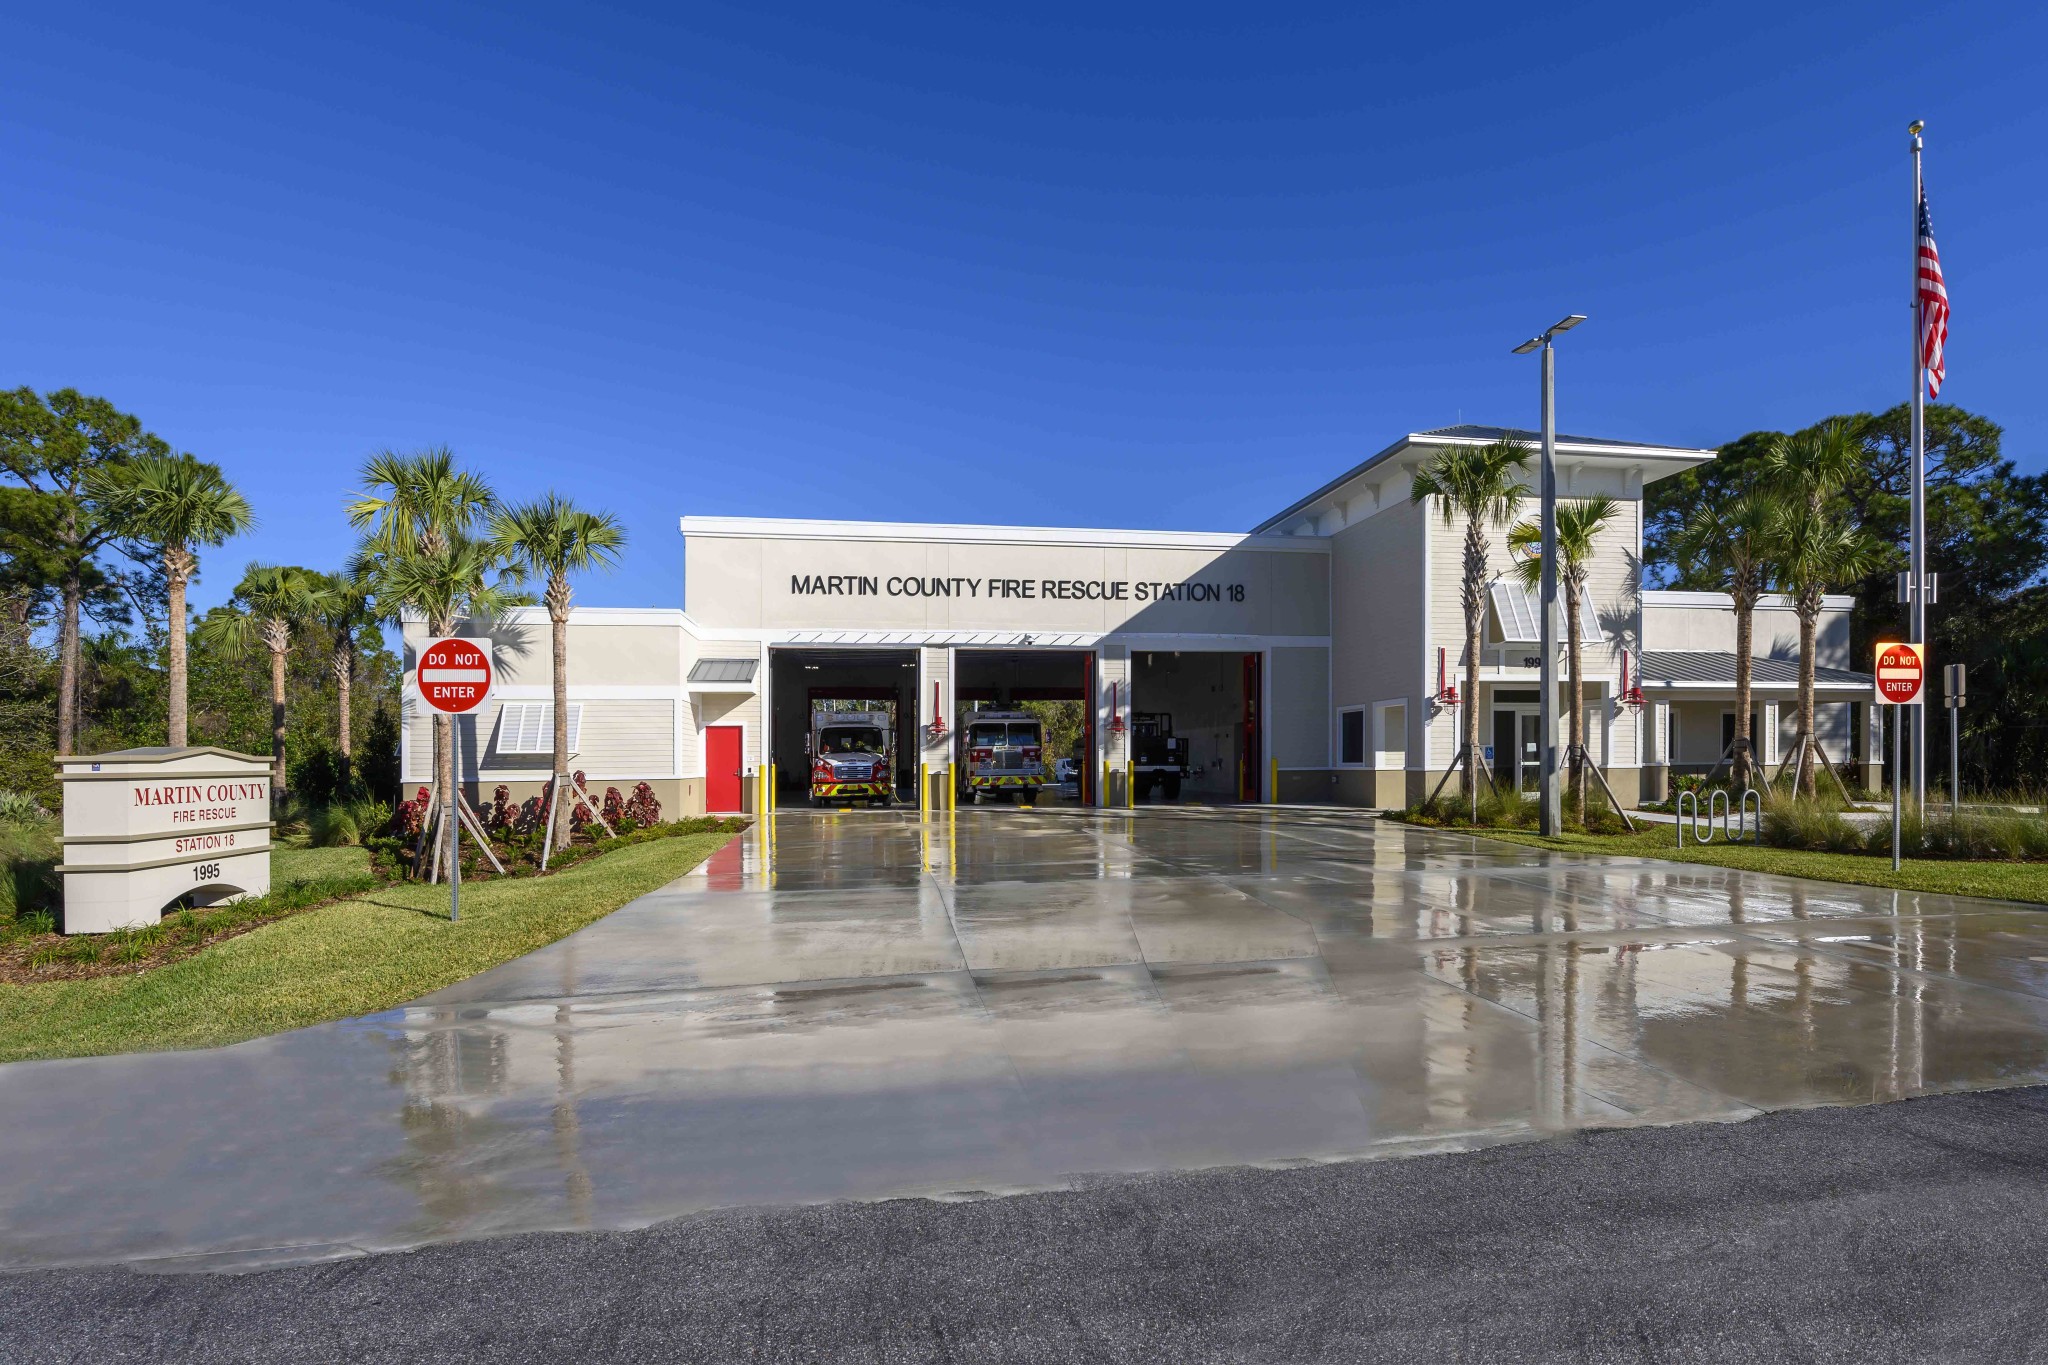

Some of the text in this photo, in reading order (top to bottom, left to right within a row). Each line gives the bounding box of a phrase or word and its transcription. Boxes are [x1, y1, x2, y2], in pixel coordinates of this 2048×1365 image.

[791, 575, 1245, 602] MARTIN COUNTY FIRE RESCUE STATION 18
[429, 654, 480, 665] DO NOT
[1523, 656, 1541, 668] 199
[1883, 656, 1916, 666] DO NOT
[433, 686, 475, 698] ENTER
[1886, 682, 1913, 692] ENTER
[134, 783, 266, 807] MARTIN COUNTY
[173, 807, 237, 823] FIRE RESCUE
[175, 834, 235, 853] STATION 18
[193, 863, 220, 881] 1995
